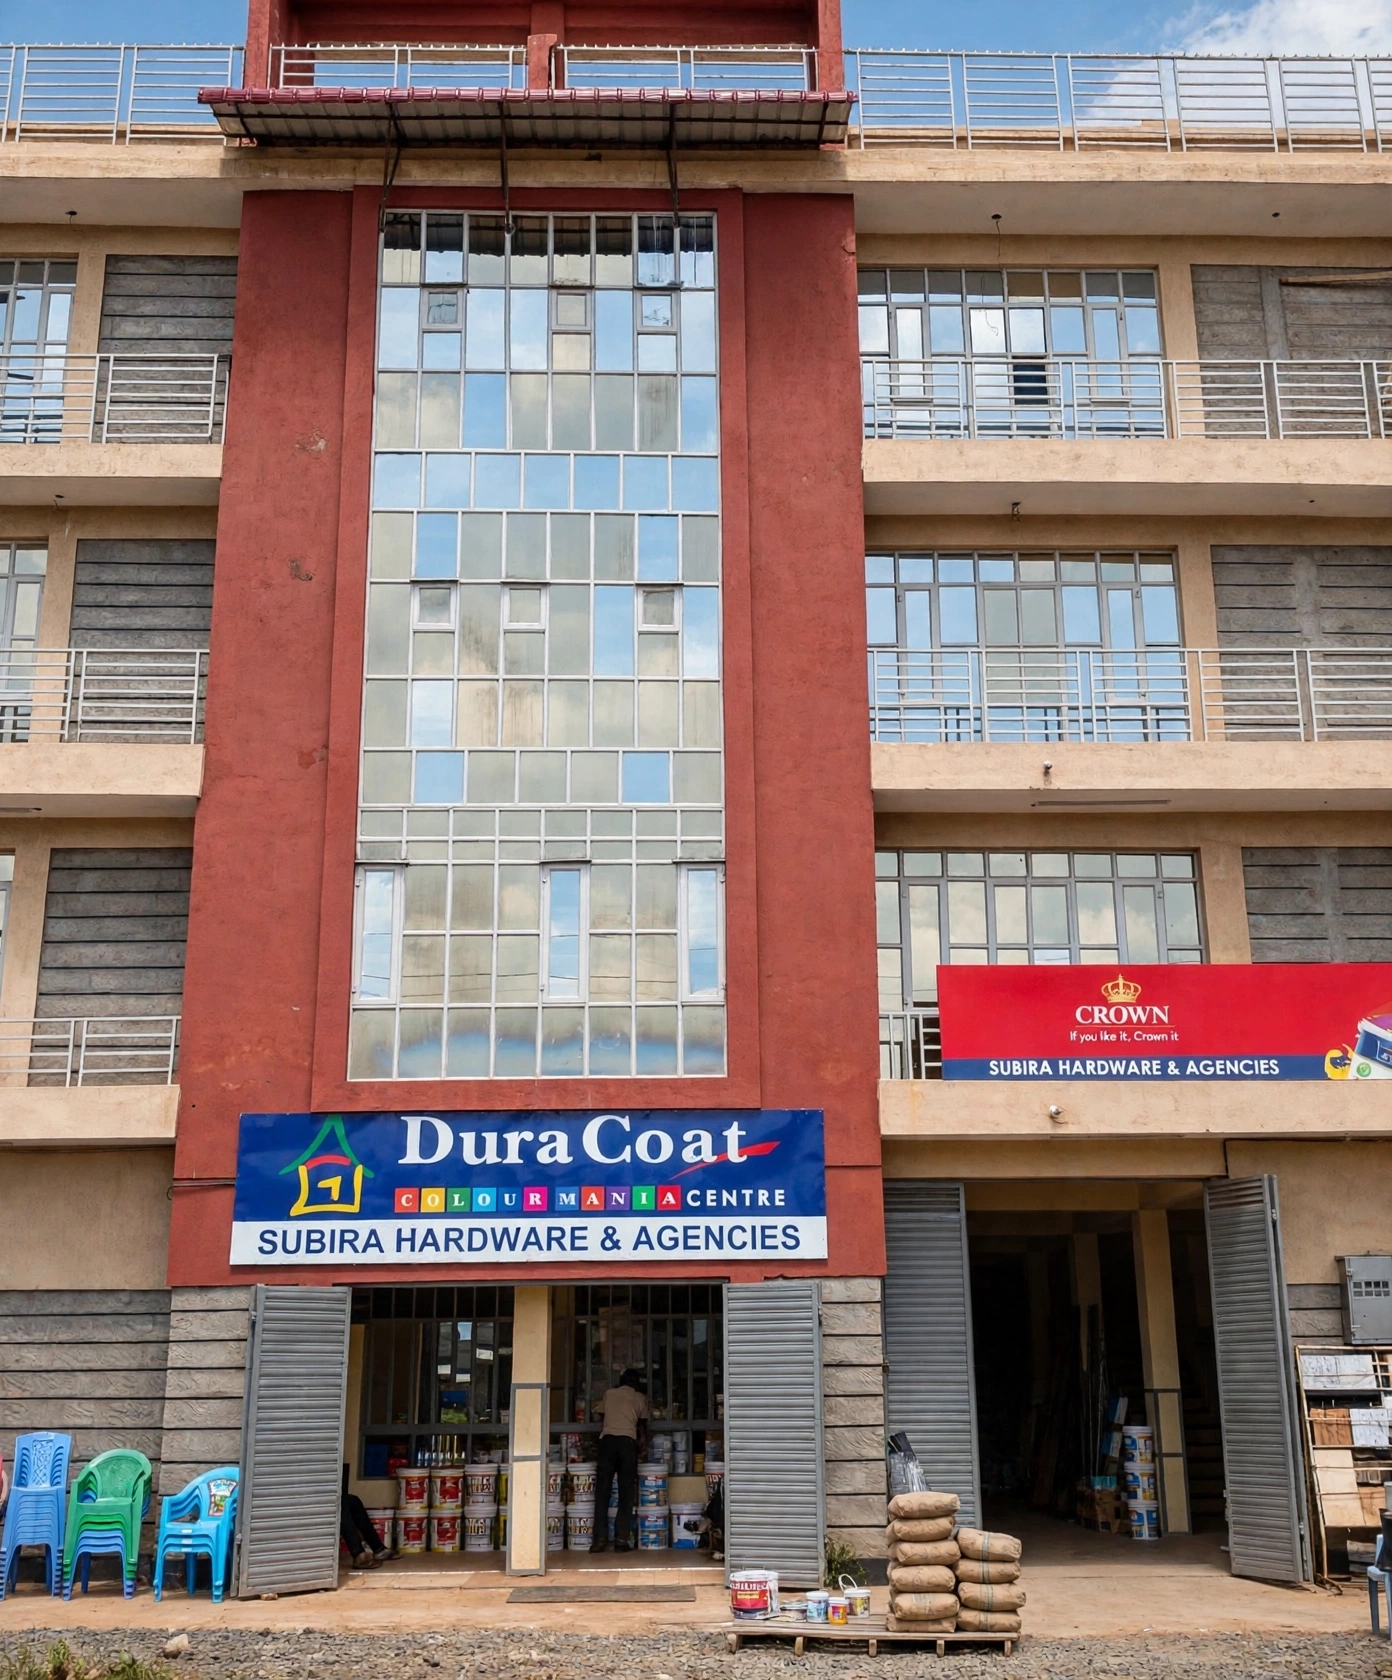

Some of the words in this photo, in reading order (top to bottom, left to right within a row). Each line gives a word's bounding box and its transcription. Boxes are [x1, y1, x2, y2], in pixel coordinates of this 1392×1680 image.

[1075, 1005, 1170, 1024] CROWN
[1069, 1030, 1078, 1041] If
[1080, 1033, 1098, 1044] you
[1133, 1030, 1169, 1041] Crown
[1170, 1030, 1179, 1041] it
[989, 1060, 1053, 1076] SUBIRA
[1058, 1059, 1162, 1076] HARDWARE
[1167, 1060, 1181, 1075] &
[1185, 1059, 1280, 1076] AGENCIES
[686, 1189, 785, 1206] CENTRE
[257, 1228, 385, 1255] SUBIRA
[395, 1225, 589, 1254] HARDWARE
[600, 1225, 622, 1252] &
[632, 1223, 801, 1251] AGENCIES
